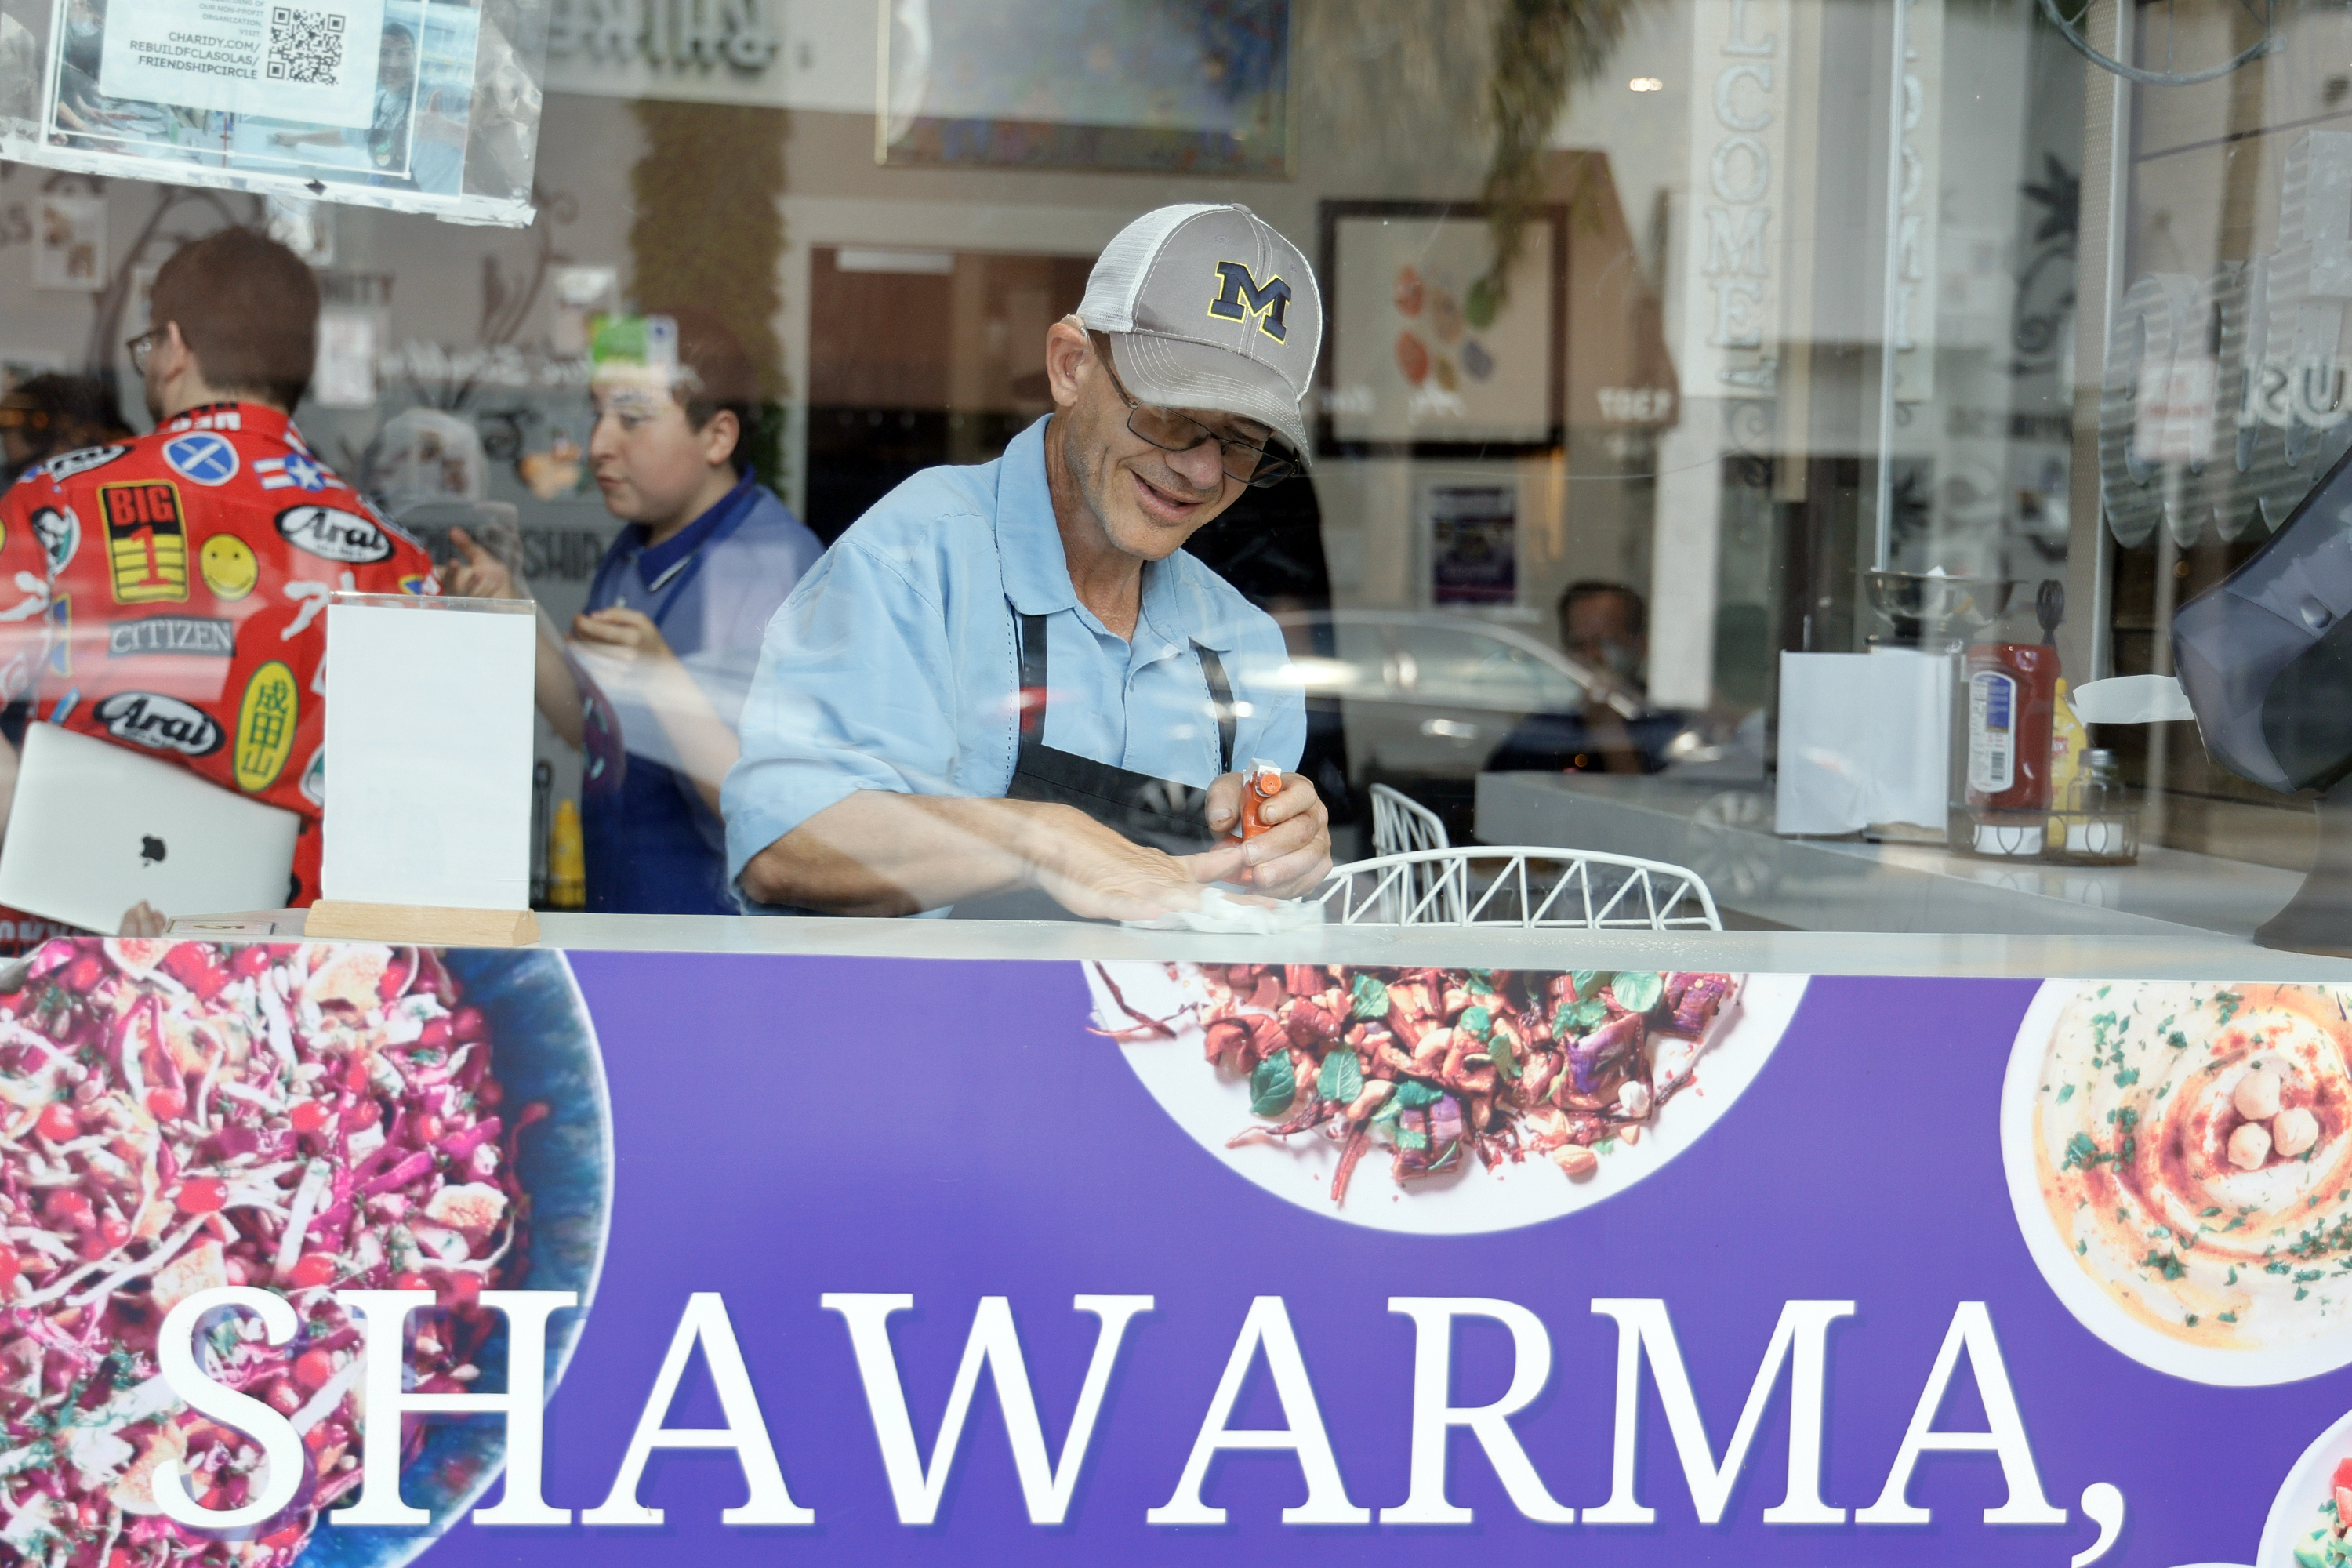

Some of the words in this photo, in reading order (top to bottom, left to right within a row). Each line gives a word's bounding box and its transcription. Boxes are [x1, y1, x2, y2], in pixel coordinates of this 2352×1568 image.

[216, 5, 264, 17] NON-PROFIT
[130, 40, 260, 67] REBUILDFCLASOLAS/
[169, 31, 261, 53] CHARIDY.COM/
[138, 55, 258, 79] FRIENDSHIPCIRCLE
[1207, 261, 1291, 345] M
[107, 485, 176, 527] BIG
[284, 512, 385, 550] Arai
[129, 524, 170, 586] 1
[111, 619, 233, 653] CITIZEN
[103, 696, 212, 745] Arai
[151, 1285, 2125, 1568] SHAWARMA,
